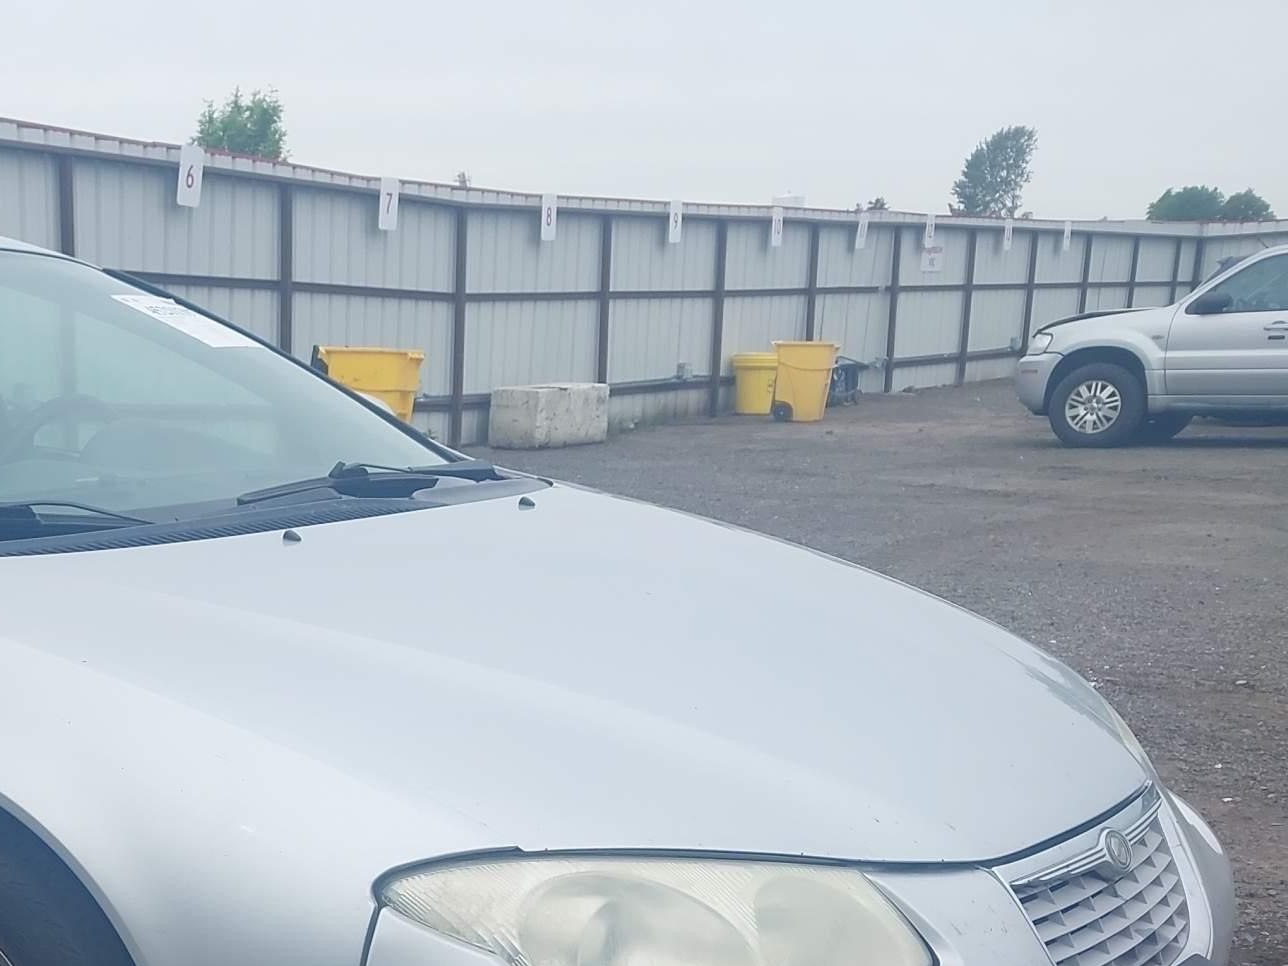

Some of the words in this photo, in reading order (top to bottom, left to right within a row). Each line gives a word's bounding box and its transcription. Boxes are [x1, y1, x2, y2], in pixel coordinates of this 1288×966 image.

[185, 164, 195, 189] 6
[385, 192, 393, 214] 7
[546, 207, 552, 227] 8
[673, 212, 679, 231] 9
